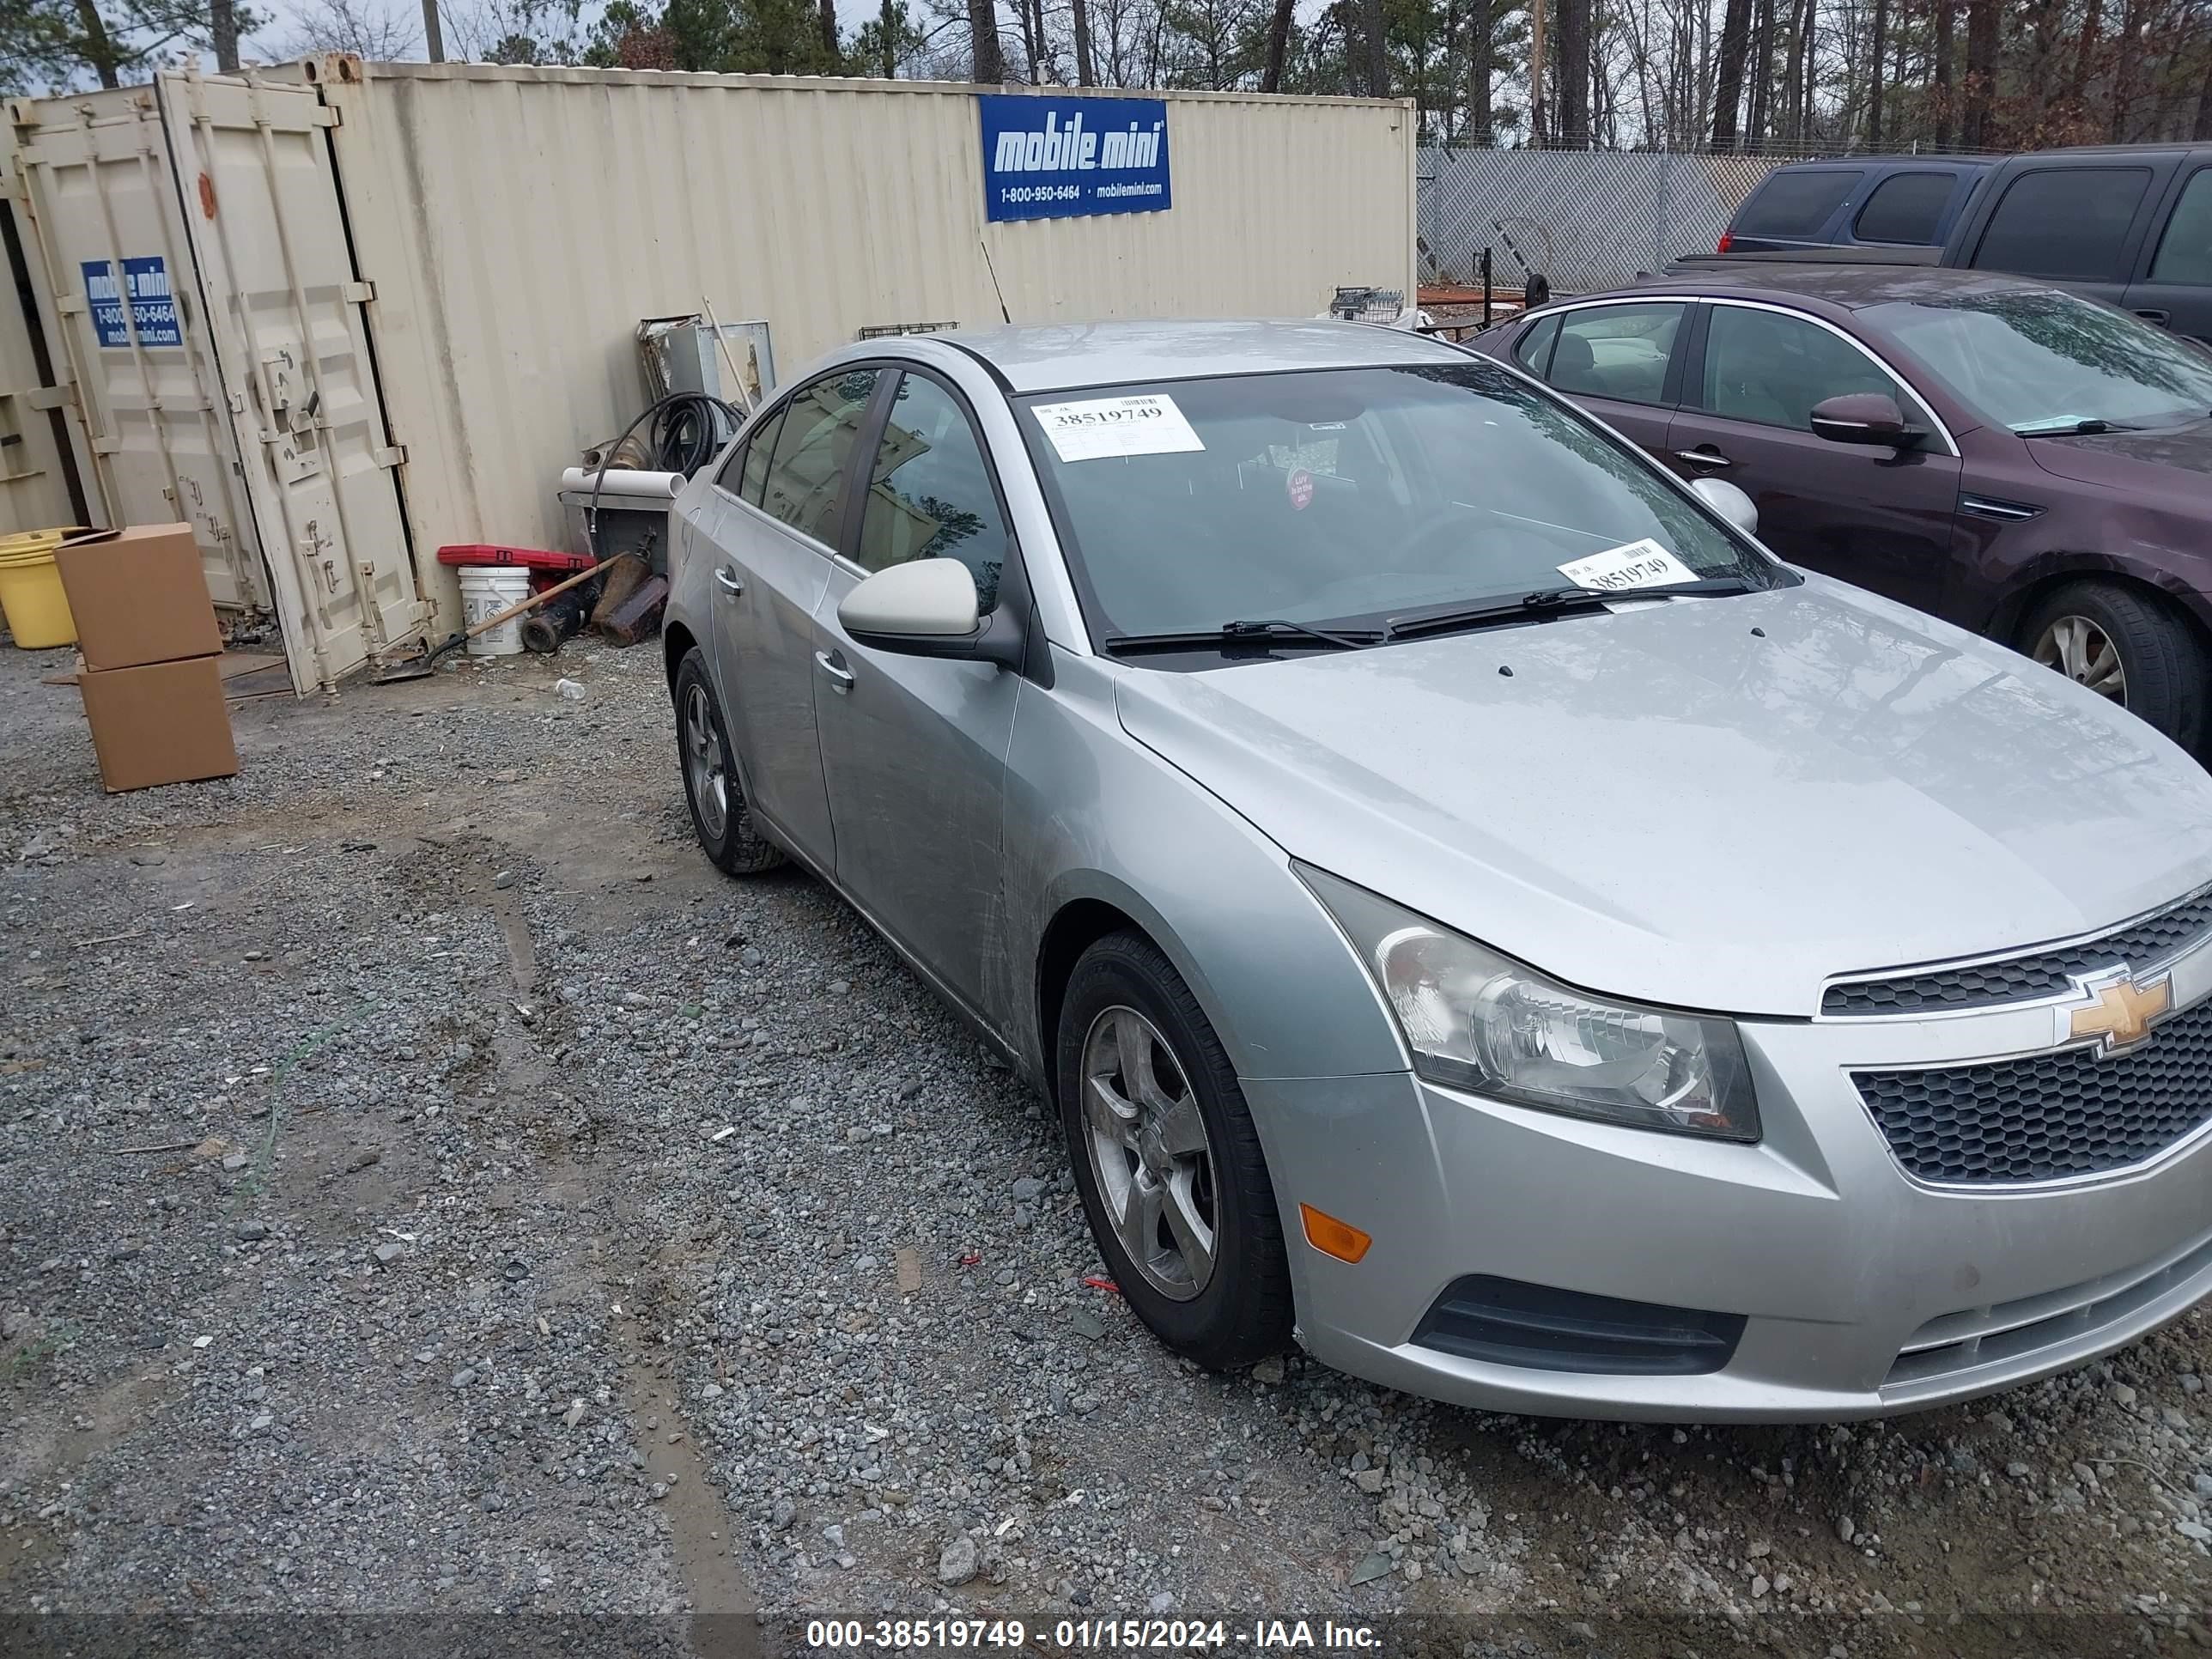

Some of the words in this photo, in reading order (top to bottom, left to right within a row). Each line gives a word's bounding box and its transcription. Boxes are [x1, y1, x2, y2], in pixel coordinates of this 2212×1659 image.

[994, 112, 1097, 172] mobile
[1000, 185, 1080, 204] 1-800-950-6464
[1097, 181, 1162, 198] mobilemini.com
[88, 263, 137, 299] mobe
[137, 266, 170, 297] mini
[97, 305, 175, 324] 1-80050-6464
[107, 326, 177, 343] mobmini.com
[1054, 406, 1162, 427] 38519749
[1589, 558, 1668, 591] 38519749
